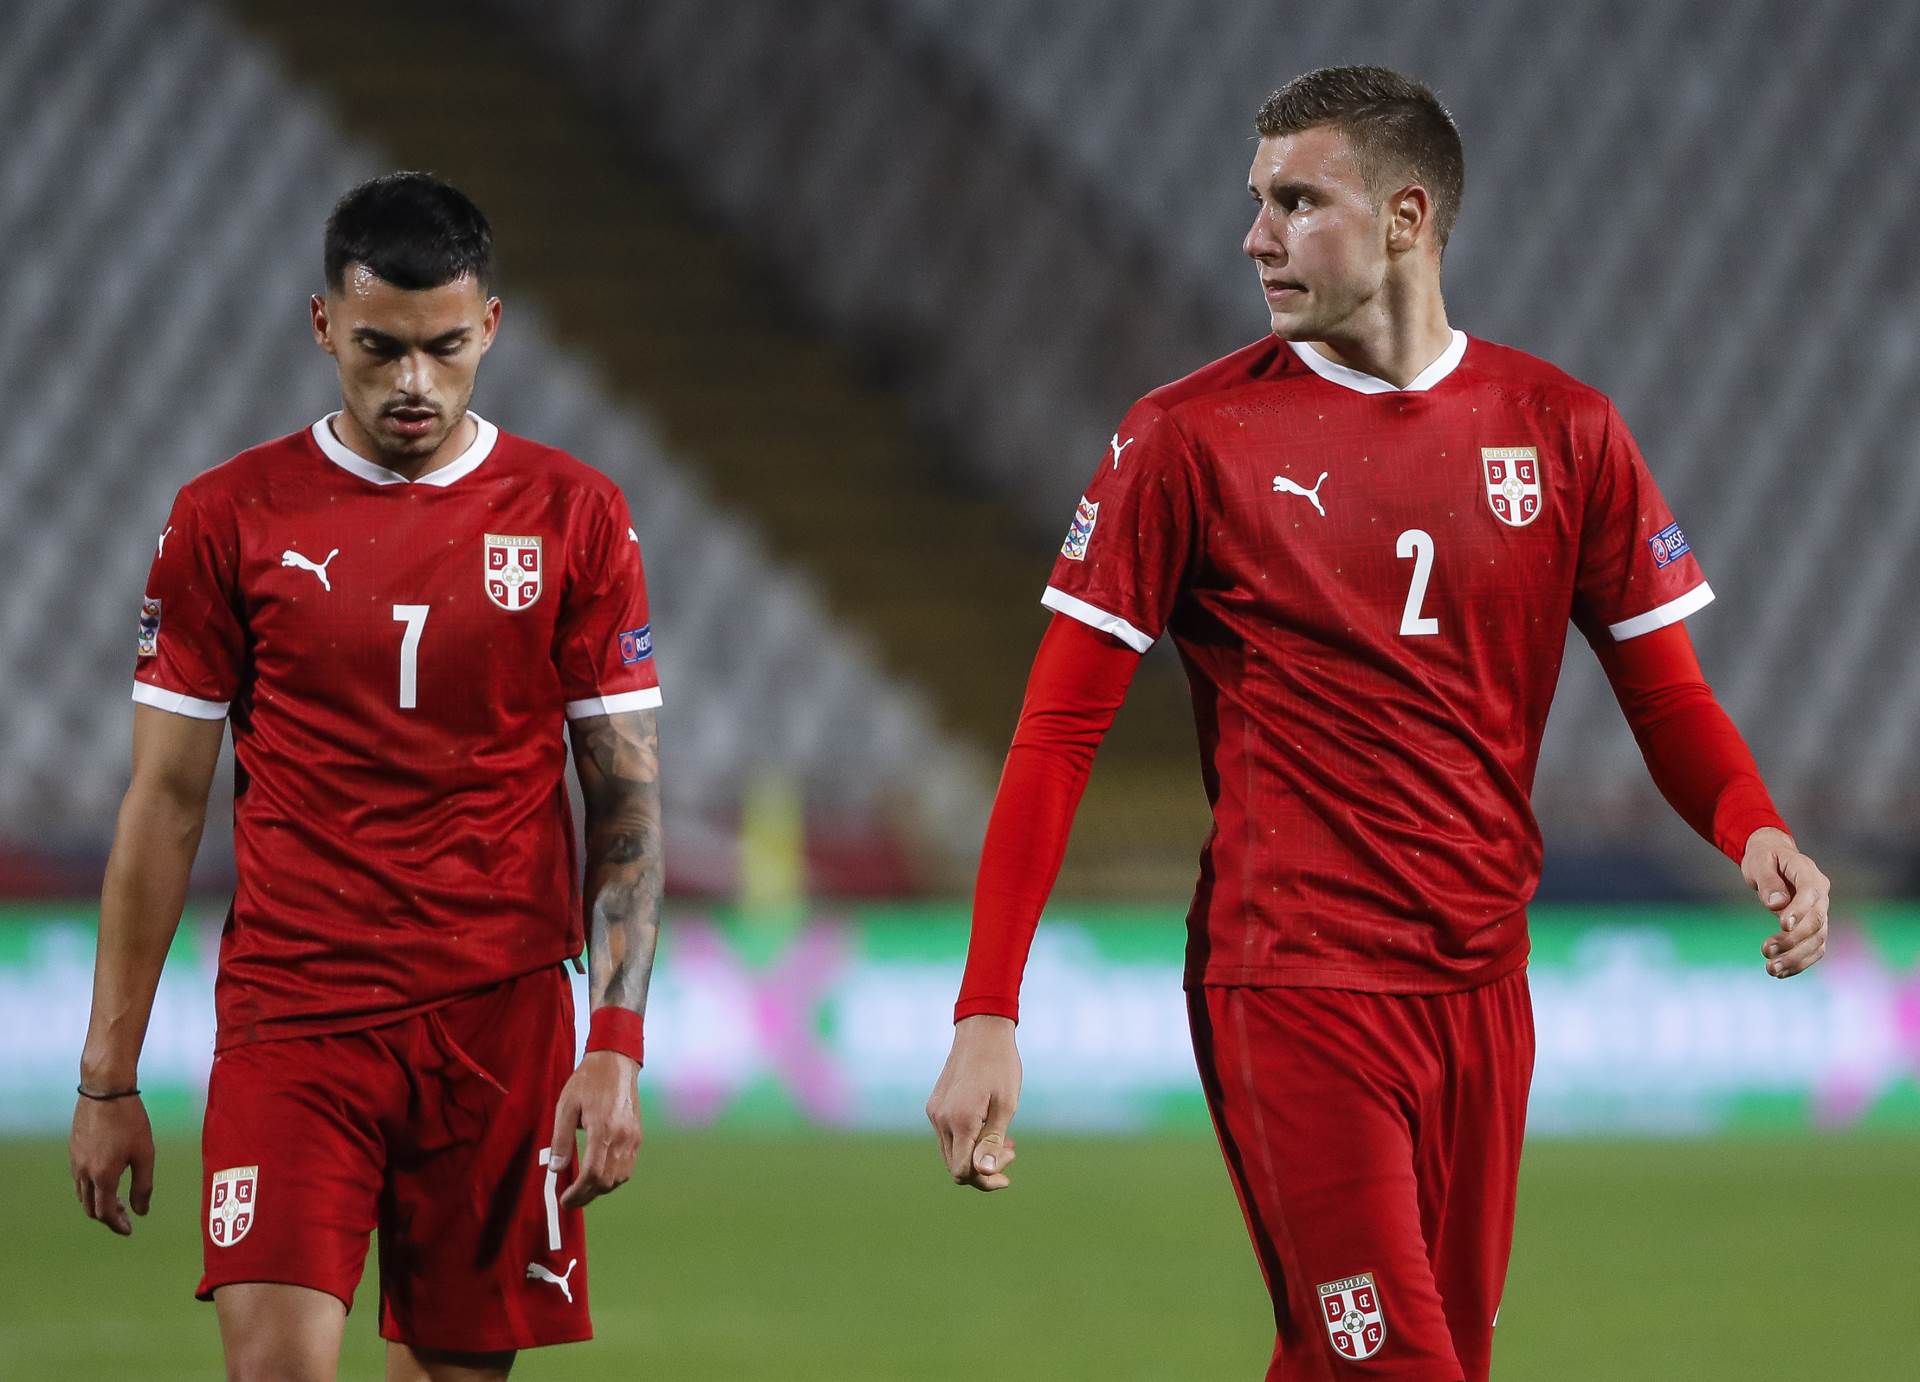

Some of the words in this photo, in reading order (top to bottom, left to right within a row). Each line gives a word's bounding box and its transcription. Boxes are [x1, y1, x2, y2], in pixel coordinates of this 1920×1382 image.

[1396, 529, 1439, 635] 2
[392, 605, 430, 708] 7
[1320, 1276, 1371, 1294] СРБИЈА
